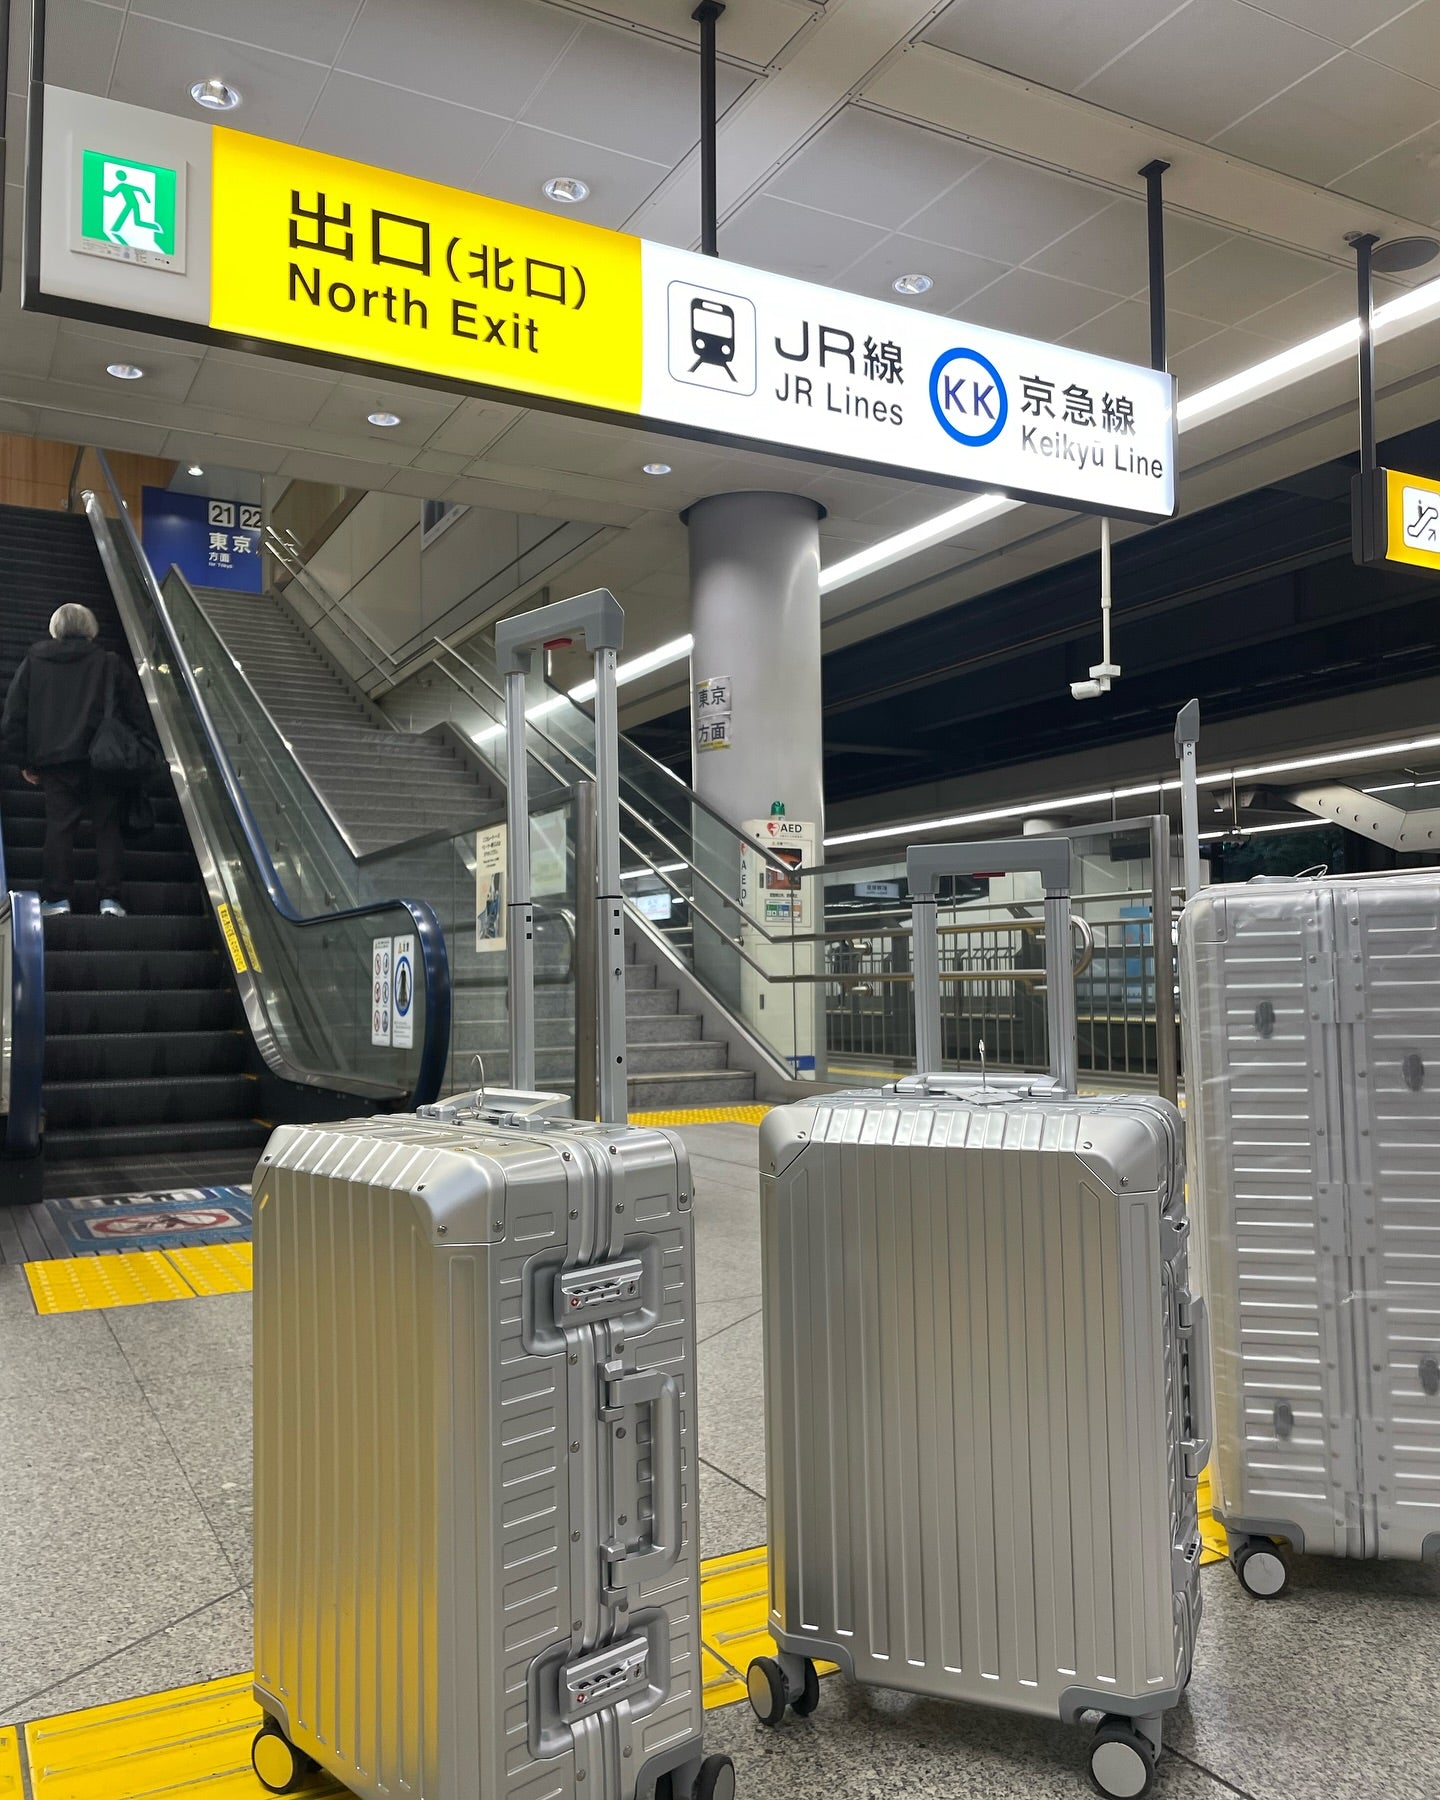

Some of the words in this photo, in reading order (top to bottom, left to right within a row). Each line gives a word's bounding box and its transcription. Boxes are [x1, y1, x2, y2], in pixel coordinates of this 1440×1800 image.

[289, 189, 586, 310] 出口(北口)
[289, 262, 428, 329] North
[452, 299, 538, 353] Exit
[775, 320, 905, 386] JR線
[775, 372, 813, 408] JR
[826, 382, 904, 426] Lines
[943, 374, 996, 420] KK
[1019, 374, 1137, 436] 京急線
[1114, 453, 1164, 480] Line
[211, 504, 232, 525] 21
[241, 509, 262, 529] 22
[698, 685, 727, 708] 東京
[698, 721, 726, 743] 方面
[780, 823, 803, 833] AED
